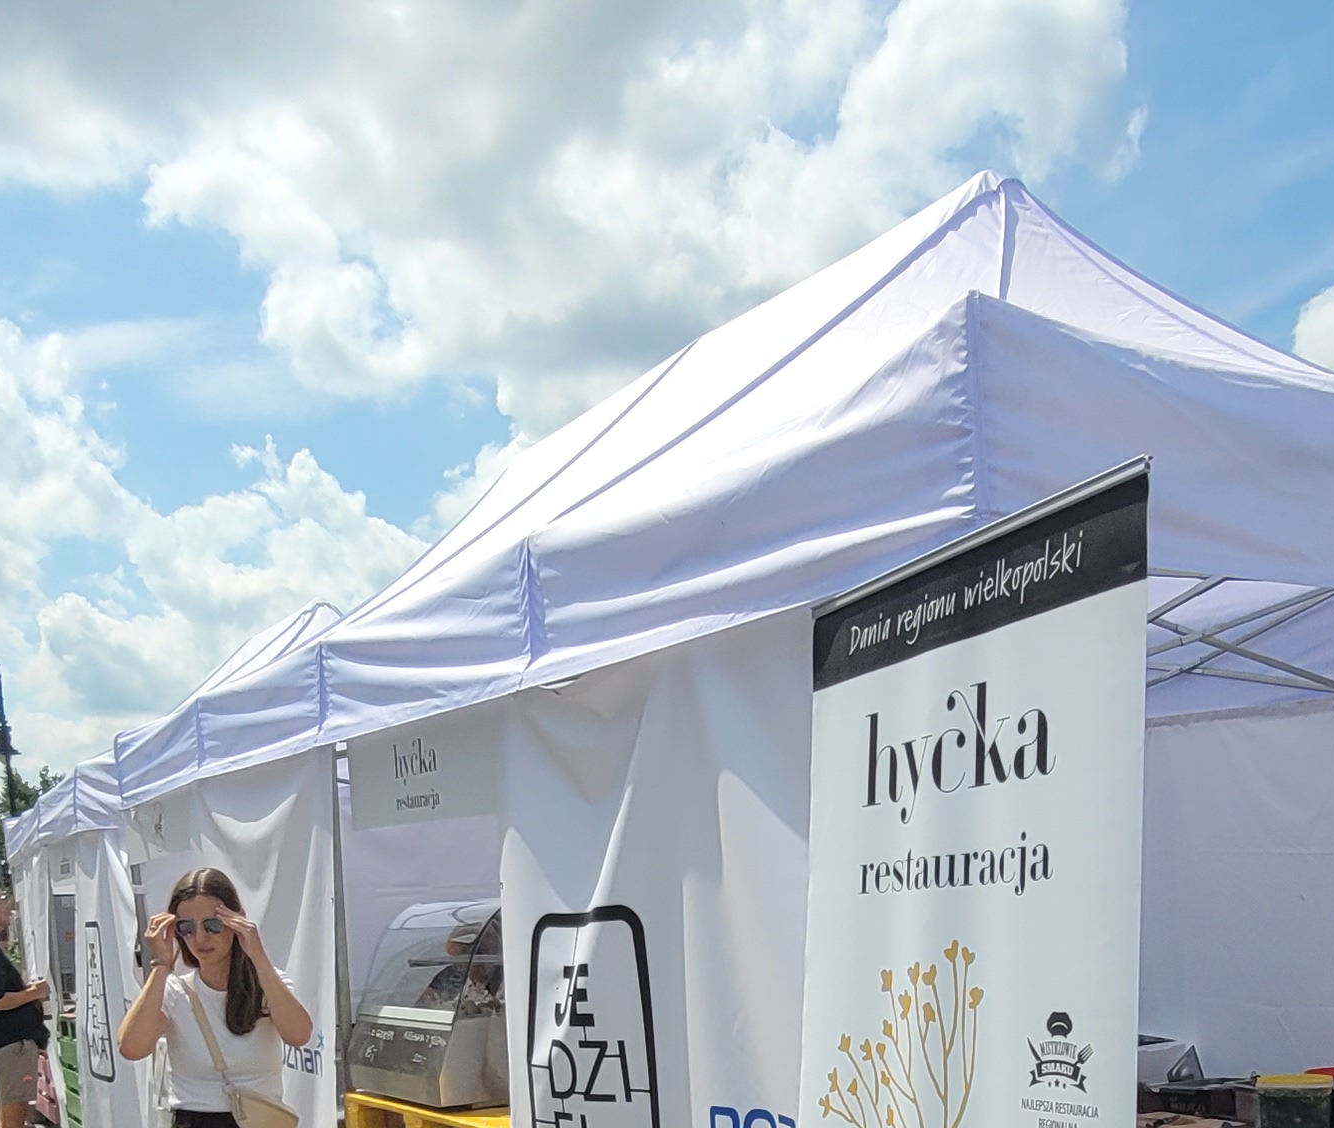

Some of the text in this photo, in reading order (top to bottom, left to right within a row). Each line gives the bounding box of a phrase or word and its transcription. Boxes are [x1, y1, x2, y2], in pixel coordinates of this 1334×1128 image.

[848, 529, 1084, 655] Dania regionu wielkopolski
[858, 832, 1053, 897] restauracja
[548, 1039, 633, 1102] DZI
[1041, 1062, 1075, 1076] SMAKU
[1021, 1098, 1099, 1119] NAJLEPSZA RESTAURACJA
